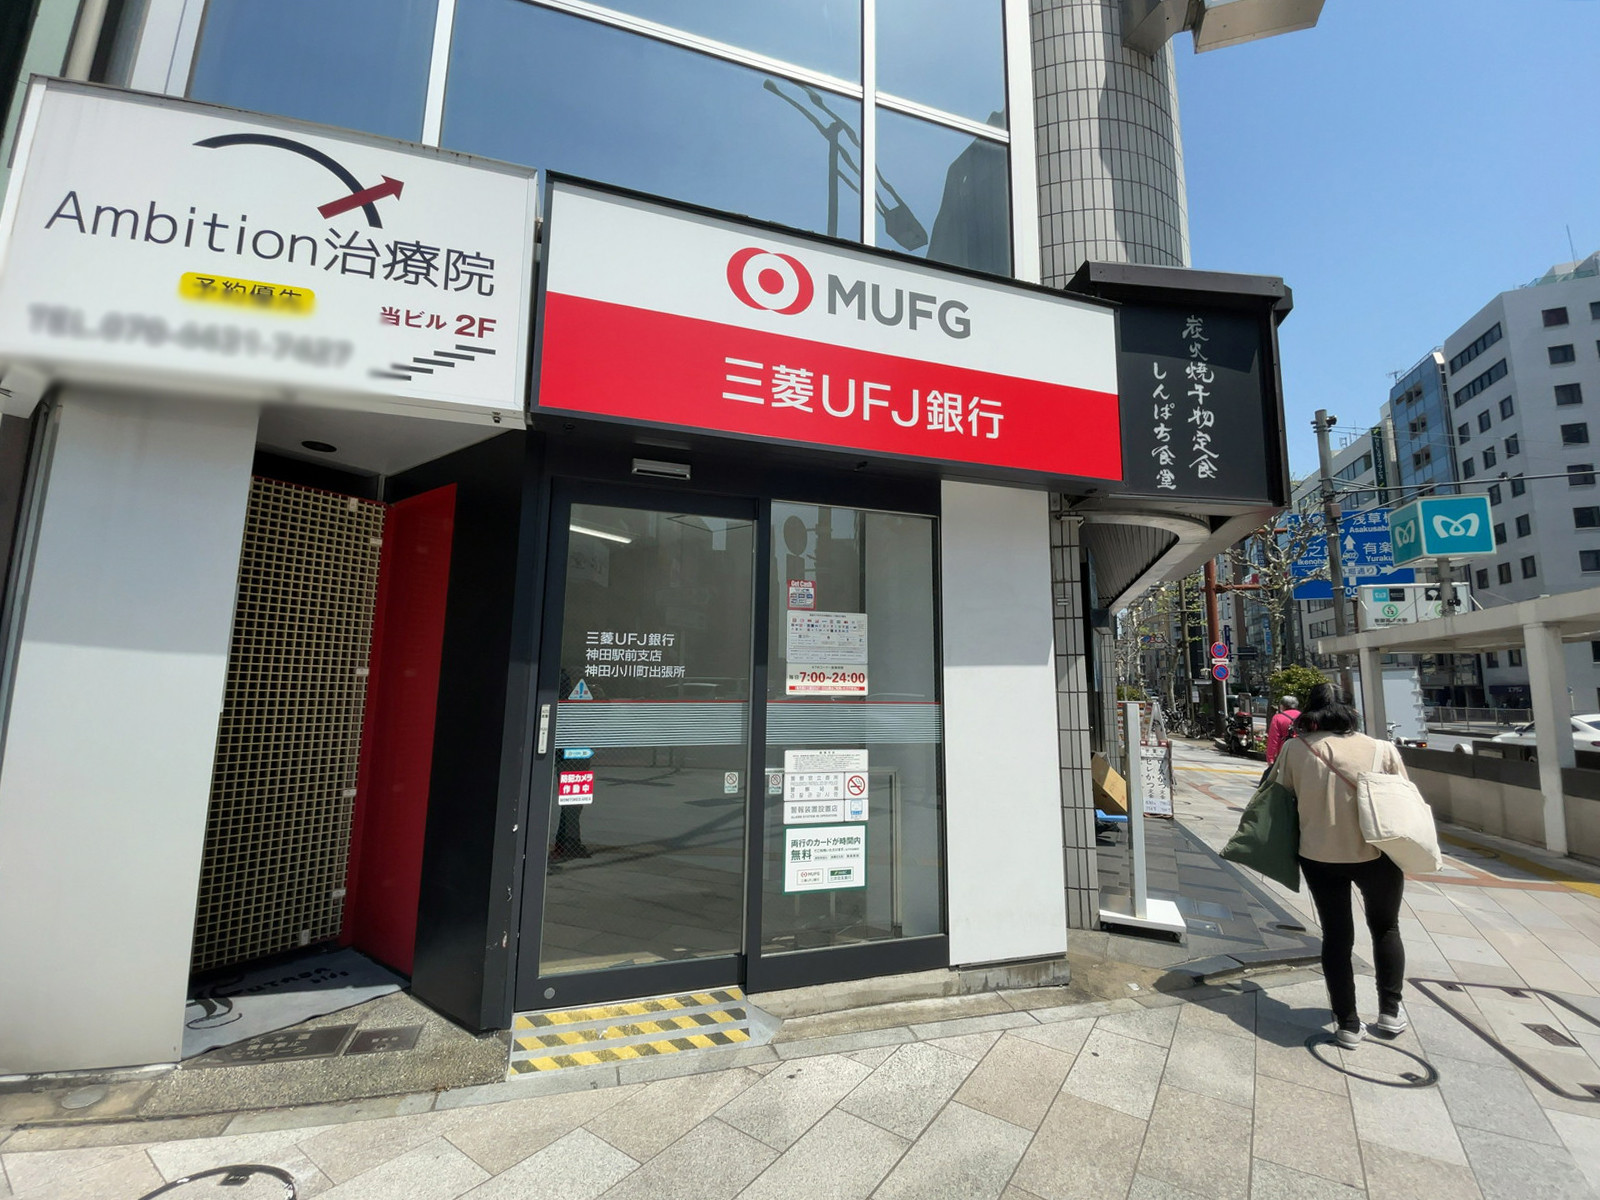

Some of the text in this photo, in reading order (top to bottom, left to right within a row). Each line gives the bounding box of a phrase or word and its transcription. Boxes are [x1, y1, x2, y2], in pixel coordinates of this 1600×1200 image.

[44, 190, 496, 298] Ambition治療院
[827, 273, 971, 339] MUFG
[455, 314, 497, 339] 2F
[722, 356, 1004, 439] 三菱UFJ銀行
[1181, 314, 1220, 479] 炭火焼干物定食
[1151, 362, 1177, 490] しんぱち食堂
[585, 631, 675, 646] 三菱UFJ銀行
[585, 648, 663, 662] 神田駅前支店
[584, 664, 686, 678] 神田小川町出張所
[791, 836, 861, 848] 両行のカードが時間内
[791, 848, 812, 861] 無料
